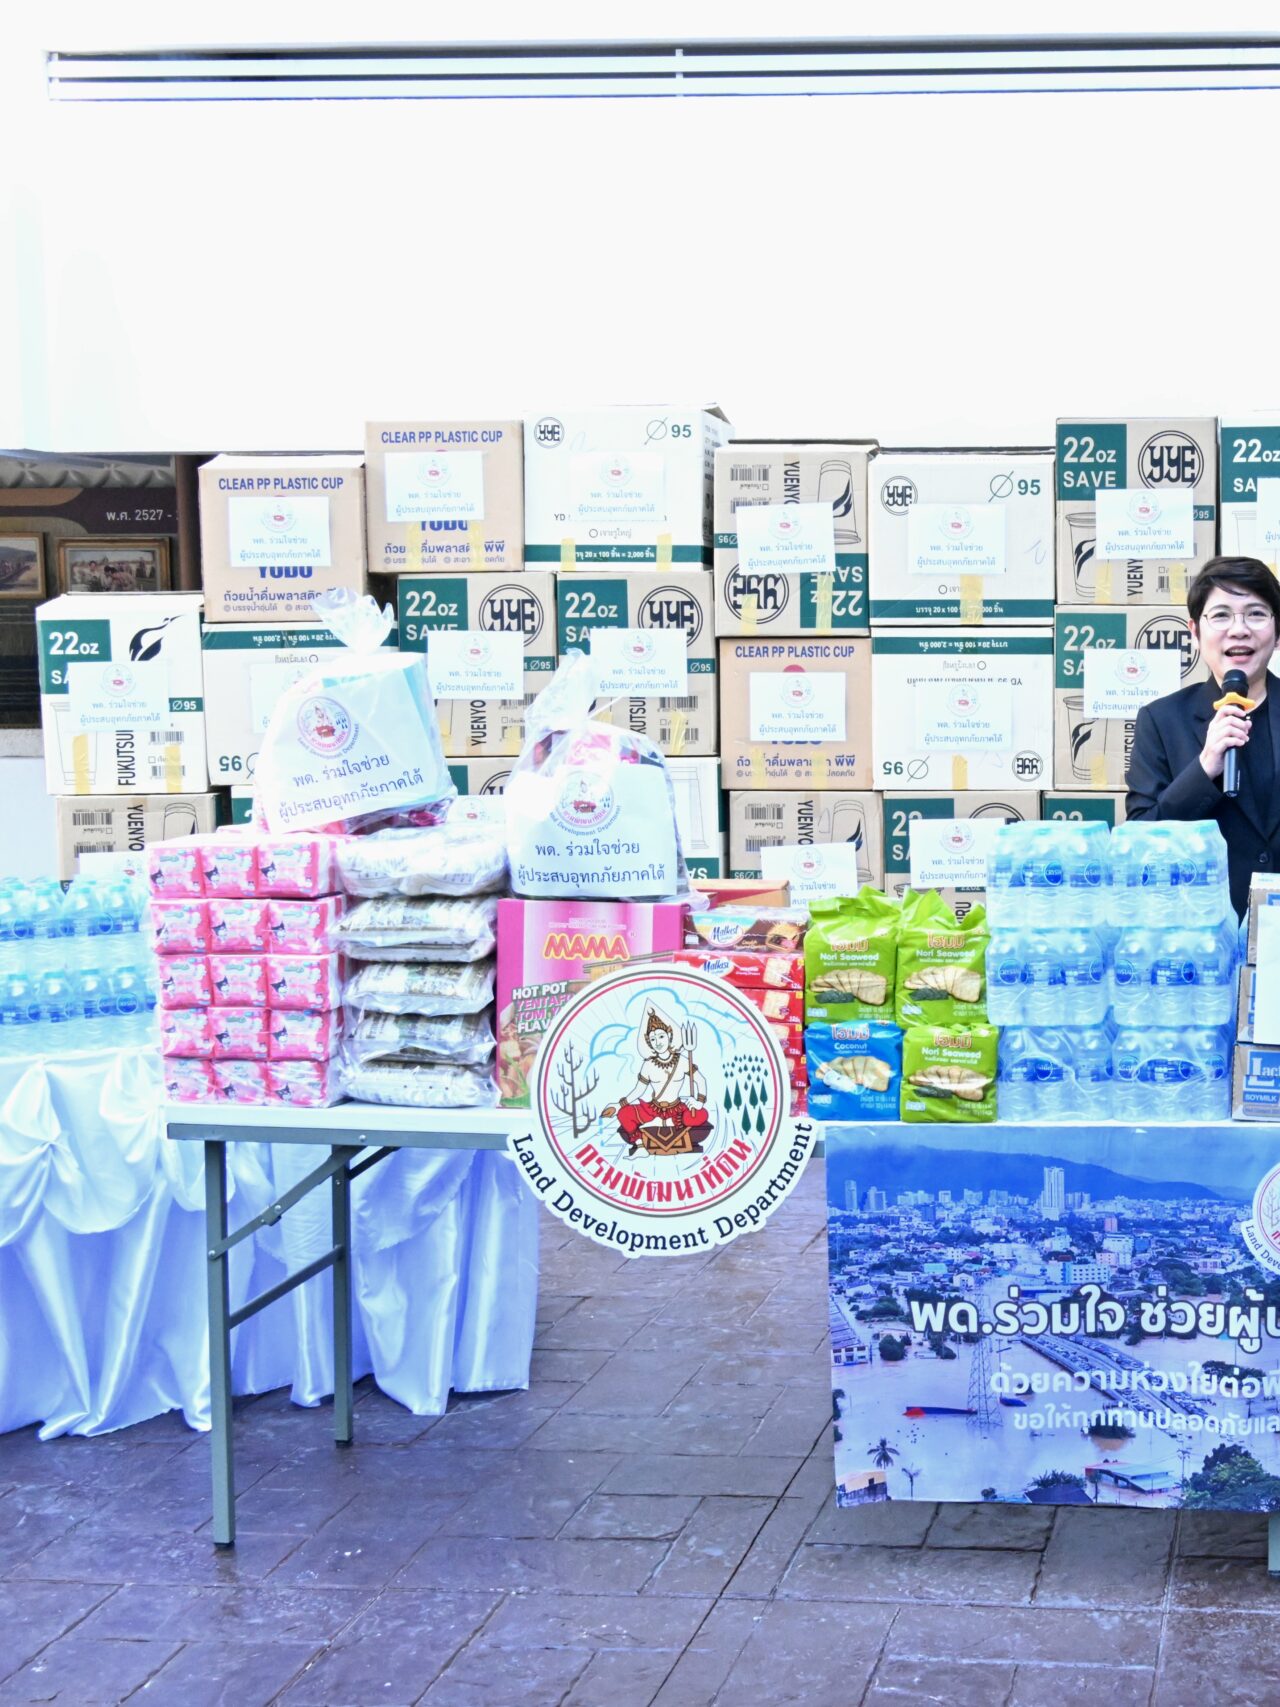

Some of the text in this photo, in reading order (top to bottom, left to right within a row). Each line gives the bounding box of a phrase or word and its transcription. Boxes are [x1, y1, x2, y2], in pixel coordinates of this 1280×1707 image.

[381, 431, 502, 443] CLEAR PP PLASTIC CUP
[1063, 437, 1116, 463] 22oz
[1233, 439, 1280, 463] 22oz
[219, 477, 343, 490] CLEAR PP PLASTIC CUP
[1063, 471, 1116, 487] SAVE
[106, 510, 163, 520] พ.ศ. 2527
[406, 591, 458, 617] 22oz
[565, 592, 618, 618] 22oz
[49, 631, 99, 655] 22oz
[735, 646, 854, 658] CLEAR PP PLASTIC CUP
[536, 839, 640, 857] พด. ร่วมใจช่วย
[518, 864, 664, 887] ผู้ประสบอุทกภัยภาคใต้
[543, 933, 630, 960] MAMA
[840, 953, 879, 961] Seaweed
[513, 982, 568, 999] HOT POT
[834, 1042, 867, 1050] Coconut
[922, 1048, 981, 1059] Nori Seaweed
[574, 1138, 753, 1202] กรมพัฒนาที่ดิน
[513, 1121, 813, 1251] Land Development Department
[1246, 1225, 1263, 1250] Land
[910, 1284, 1126, 1335] พด.ร่วมใจ
